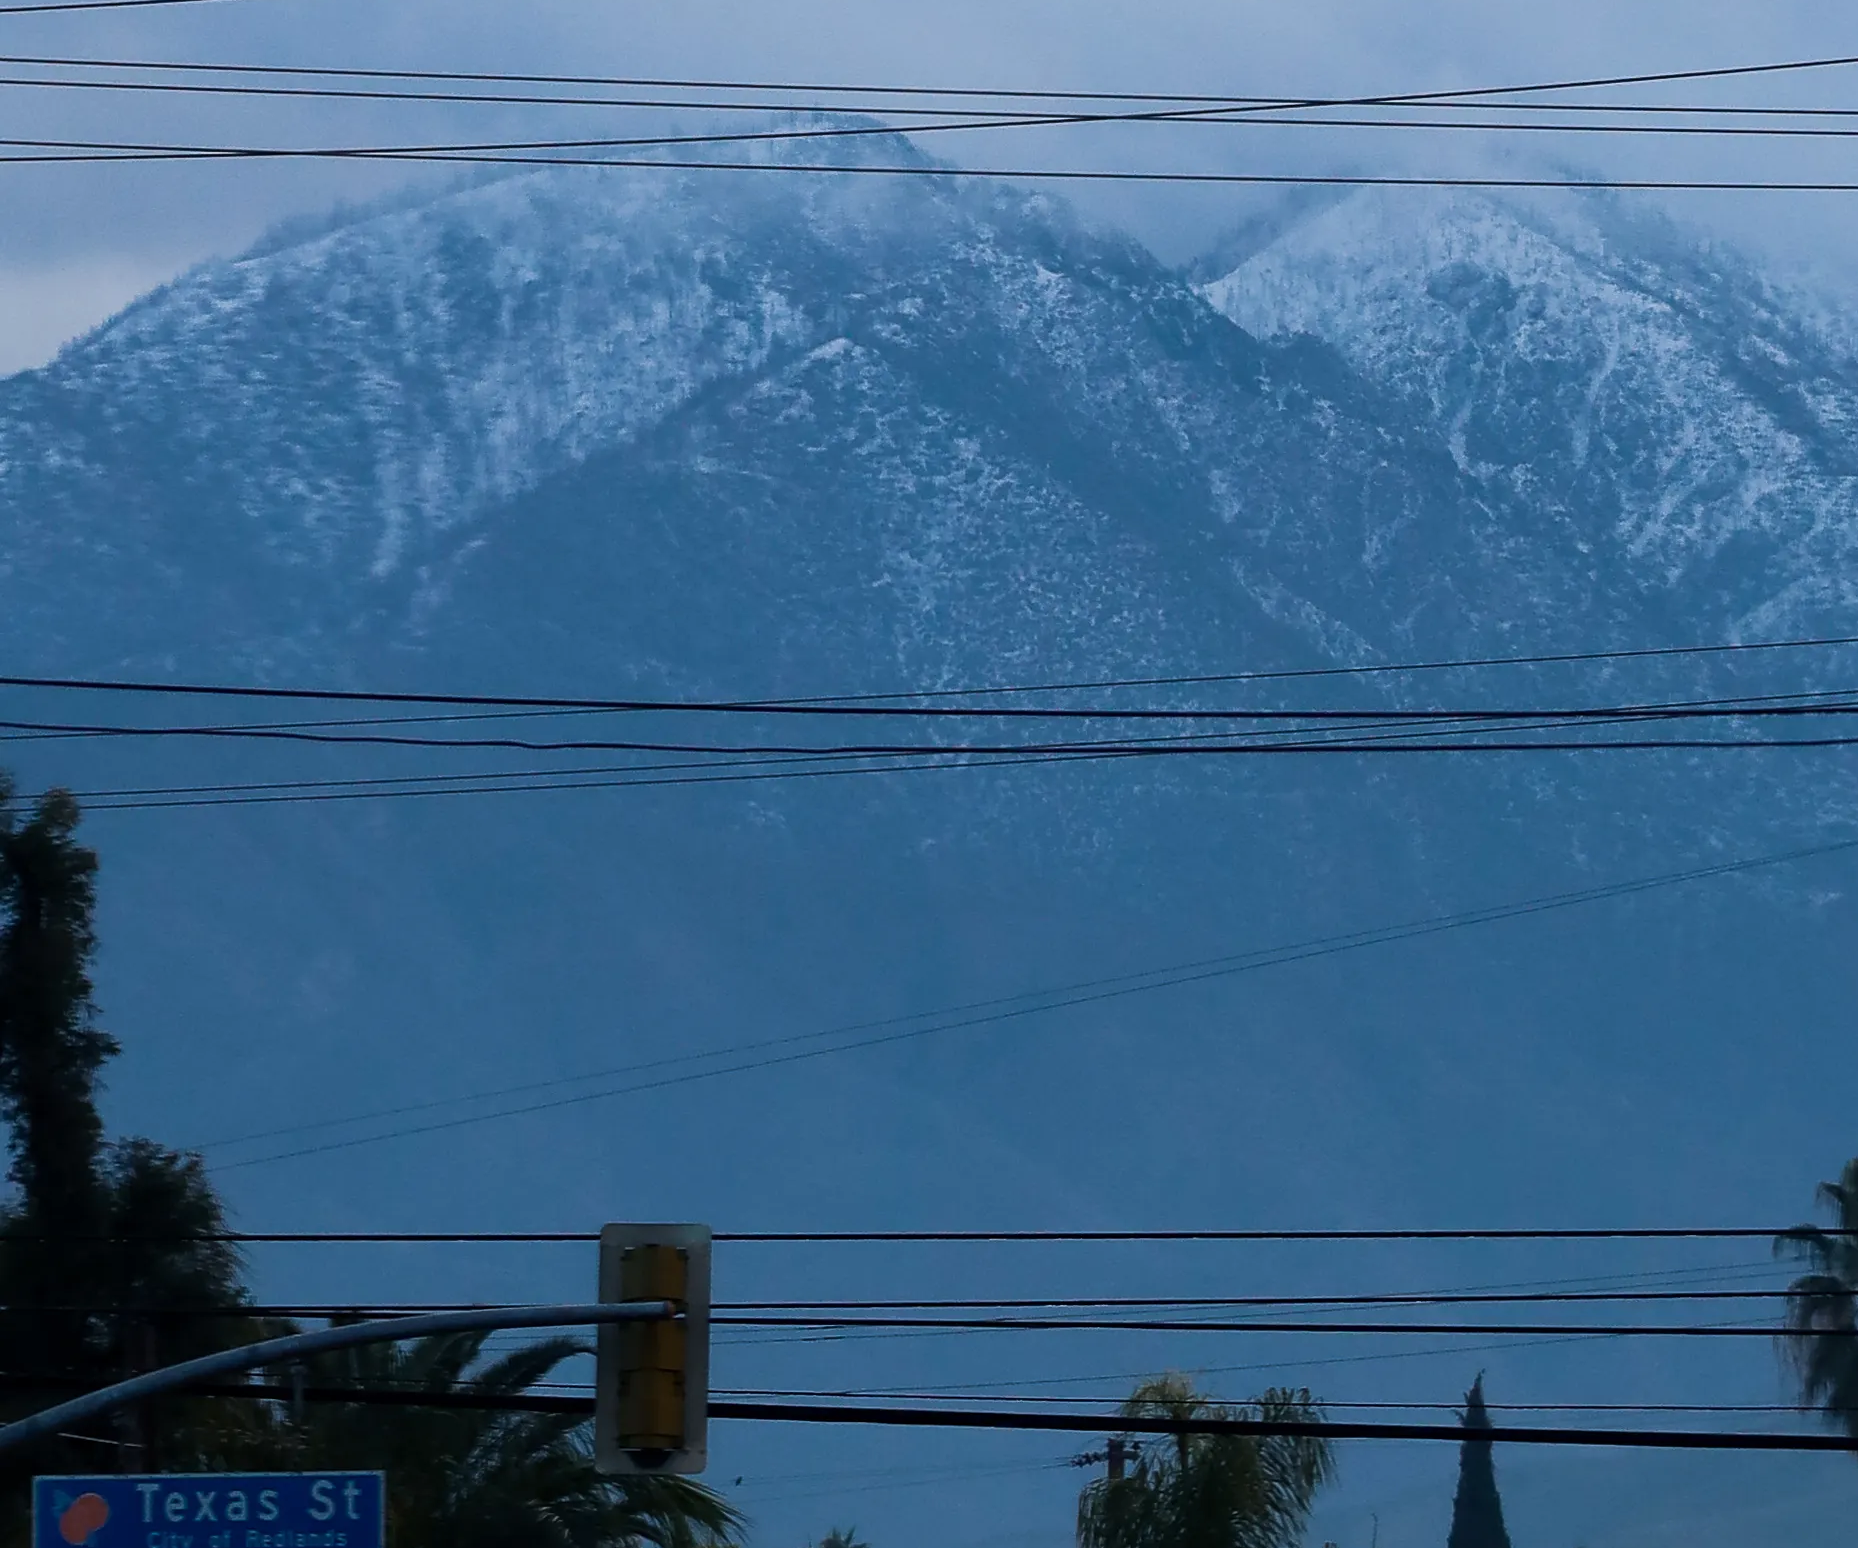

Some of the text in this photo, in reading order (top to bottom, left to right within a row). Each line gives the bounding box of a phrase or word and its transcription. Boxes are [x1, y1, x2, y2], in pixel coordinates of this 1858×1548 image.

[136, 1479, 364, 1523] Texas St
[209, 1529, 232, 1548] of
[246, 1529, 348, 1548] Redlands
